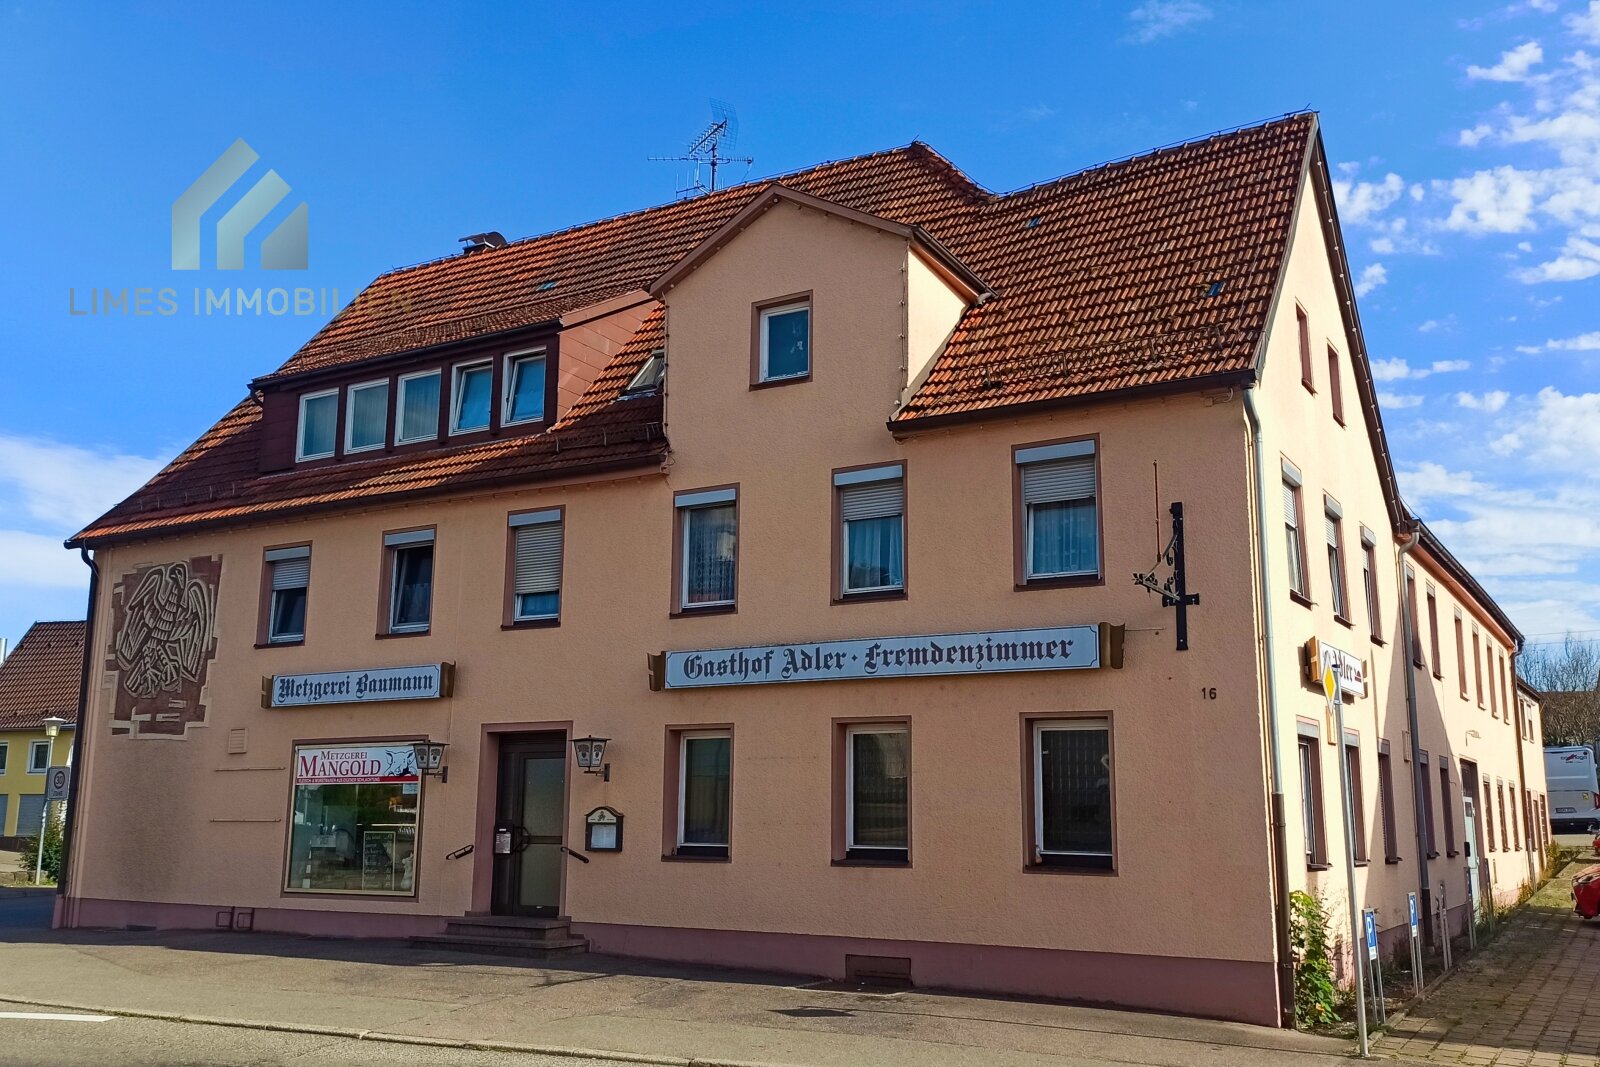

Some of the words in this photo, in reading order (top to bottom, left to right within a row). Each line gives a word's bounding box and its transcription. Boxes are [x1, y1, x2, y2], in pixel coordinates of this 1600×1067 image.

[683, 650, 775, 681] Gasthof
[781, 646, 848, 679] Adler
[864, 637, 1074, 674] Fremdenzimmer
[278, 675, 351, 703] Metzgerei
[355, 673, 433, 699] Baumann
[1201, 687, 1217, 700] 16
[299, 755, 382, 777] MANGOLD
[56, 775, 63, 785] 30
